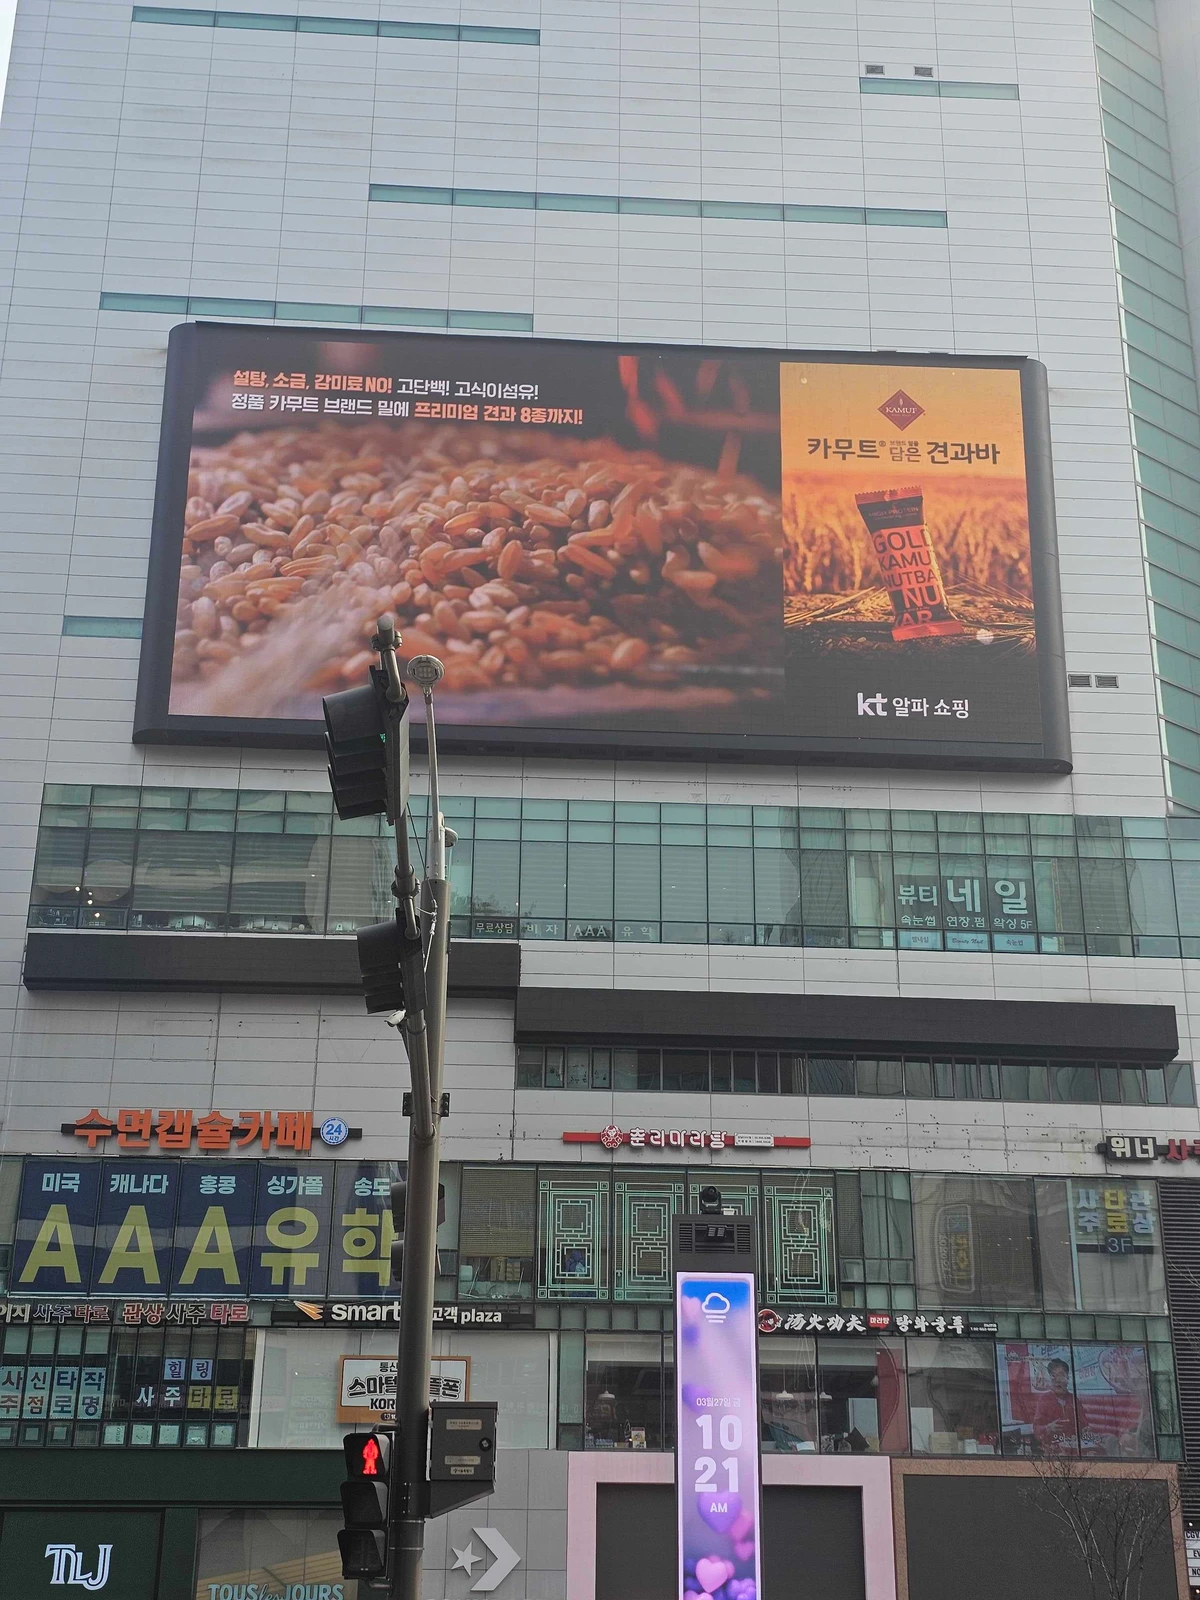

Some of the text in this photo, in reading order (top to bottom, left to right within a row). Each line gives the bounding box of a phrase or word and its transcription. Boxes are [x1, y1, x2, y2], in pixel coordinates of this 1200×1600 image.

[234, 370, 269, 389] 설탕,
[273, 373, 310, 391] 소금,
[397, 378, 450, 396] 고단백!
[454, 381, 539, 400] 고식이섬유!
[231, 393, 583, 425] 정품 카무트 브랜드 밀에 프리미엄 견과 8종까지!
[885, 405, 918, 415] KAMUT
[889, 446, 922, 462] 담은
[926, 441, 1001, 465] 견과바
[857, 692, 969, 719] kt 알파 쇼핑
[897, 878, 1028, 914] 뷰티 네일
[475, 923, 514, 934] 무료상담
[573, 925, 607, 937] AAA
[901, 914, 936, 927] 속눈썹
[994, 918, 1017, 930] 왁싱
[1020, 920, 1033, 930] 5F
[74, 1108, 313, 1150] 수면캡슐카페
[325, 1122, 343, 1136] 24
[629, 1127, 727, 1149] 춘리마라탕
[1110, 1137, 1155, 1158] 위너
[42, 1173, 391, 1197] 미국 캐나다 홍콩 싱가폴 송도
[1107, 1237, 1132, 1253] 3F
[33, 1303, 72, 1324] 사주
[74, 1304, 110, 1324] 타로
[123, 1303, 250, 1325] 관상 사주 타로
[331, 1301, 400, 1321] smart
[460, 1308, 502, 1325] plaza
[869, 1316, 890, 1325] 마라탕
[370, 1398, 397, 1410] KOR
[695, 1414, 743, 1451] 10
[694, 1456, 739, 1493] 21
[709, 1502, 728, 1513] AM
[207, 1584, 258, 1600] TOUS
[284, 1584, 344, 1600] JOURS
